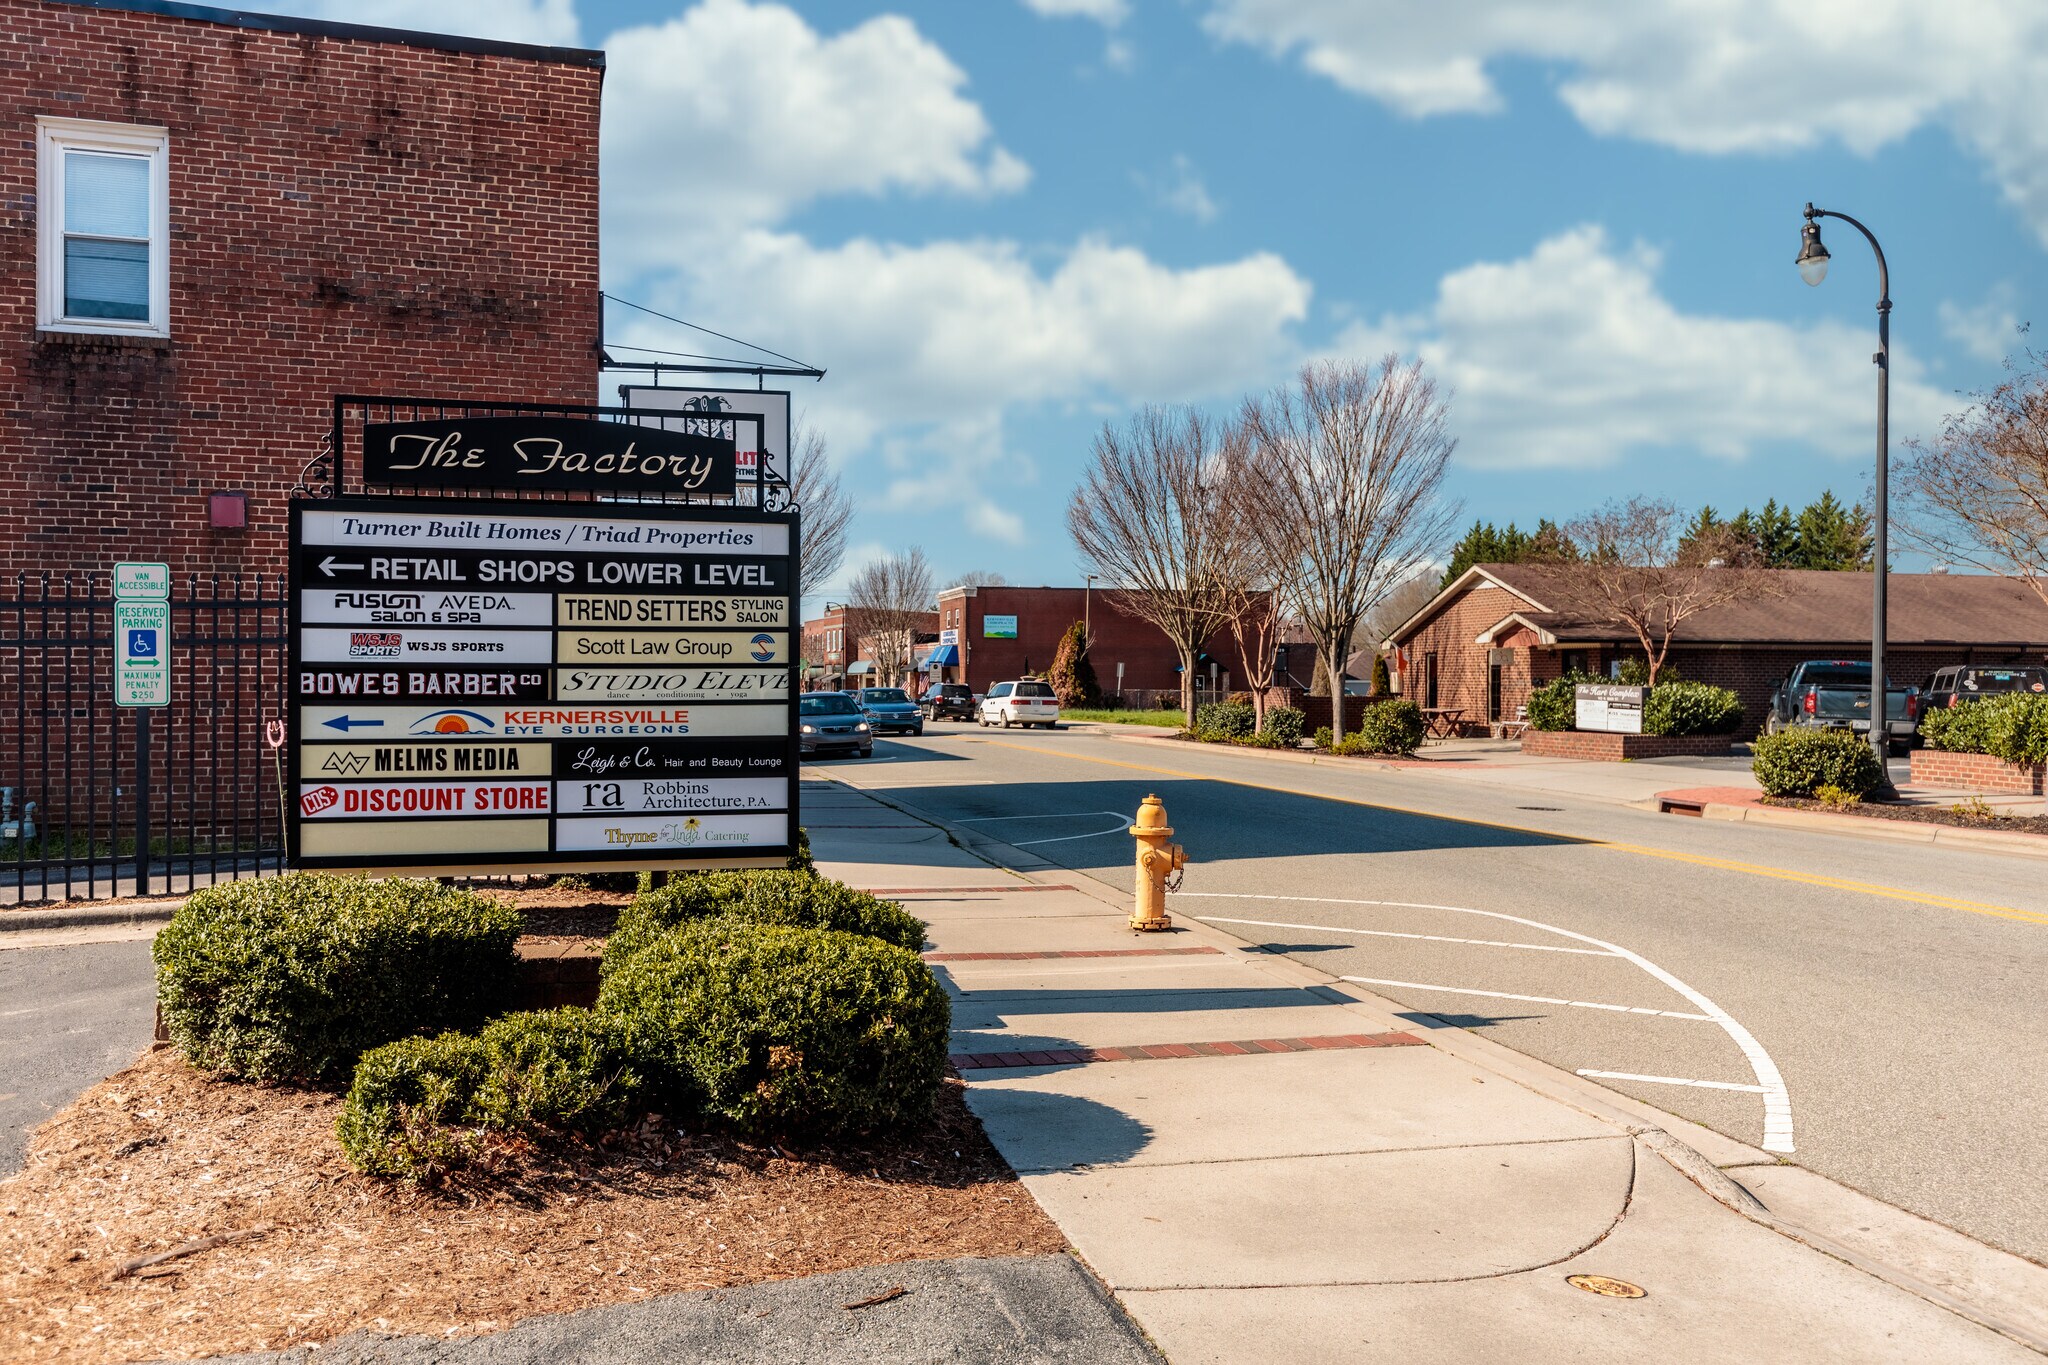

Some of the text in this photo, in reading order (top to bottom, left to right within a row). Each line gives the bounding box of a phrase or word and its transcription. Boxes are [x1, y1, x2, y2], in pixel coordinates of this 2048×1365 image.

[388, 431, 713, 489] The Factory
[343, 518, 422, 536] Turner
[426, 521, 482, 539] Built
[486, 522, 561, 540] Homes
[582, 525, 641, 543] Triad
[645, 527, 754, 548] Properties
[371, 557, 774, 586] RETAIL SHOPS LOWER LEVEL
[119, 582, 165, 590] ACCESSIBLE
[565, 599, 727, 622] TREND SETTERS
[731, 599, 784, 610] STYLING
[119, 607, 166, 617] RESERVED
[431, 612, 442, 623] &
[736, 612, 778, 623] SALON
[122, 618, 163, 629] PARKING
[351, 633, 401, 646] WSJS
[350, 646, 400, 656] SPORTS
[407, 642, 504, 652] WSJS SPORTS
[577, 638, 733, 659] Scott Law Group
[126, 681, 159, 689] PENALTY
[301, 673, 399, 695] BOWES
[408, 673, 516, 696] BARBER
[562, 671, 688, 691] STUDIO
[131, 690, 154, 699] $250
[607, 691, 630, 699] dance
[656, 691, 705, 700] conditioning
[1608, 686, 1640, 700] Complex
[504, 710, 689, 724] KERNERSVILLE
[505, 725, 690, 735] EYE SURGEONS
[375, 748, 520, 772] MELMS MEDIA
[571, 747, 616, 773] Leigh
[619, 756, 631, 768] &
[664, 757, 782, 768] Hair and Beauty Lounge
[643, 781, 709, 795] Robbins
[344, 788, 466, 812] DISCOUNT
[474, 787, 548, 810] STORE
[643, 795, 771, 809] Architecture, P.A.
[605, 828, 658, 847] Thyme
[667, 824, 701, 846] Linda
[705, 830, 750, 842] Catering
